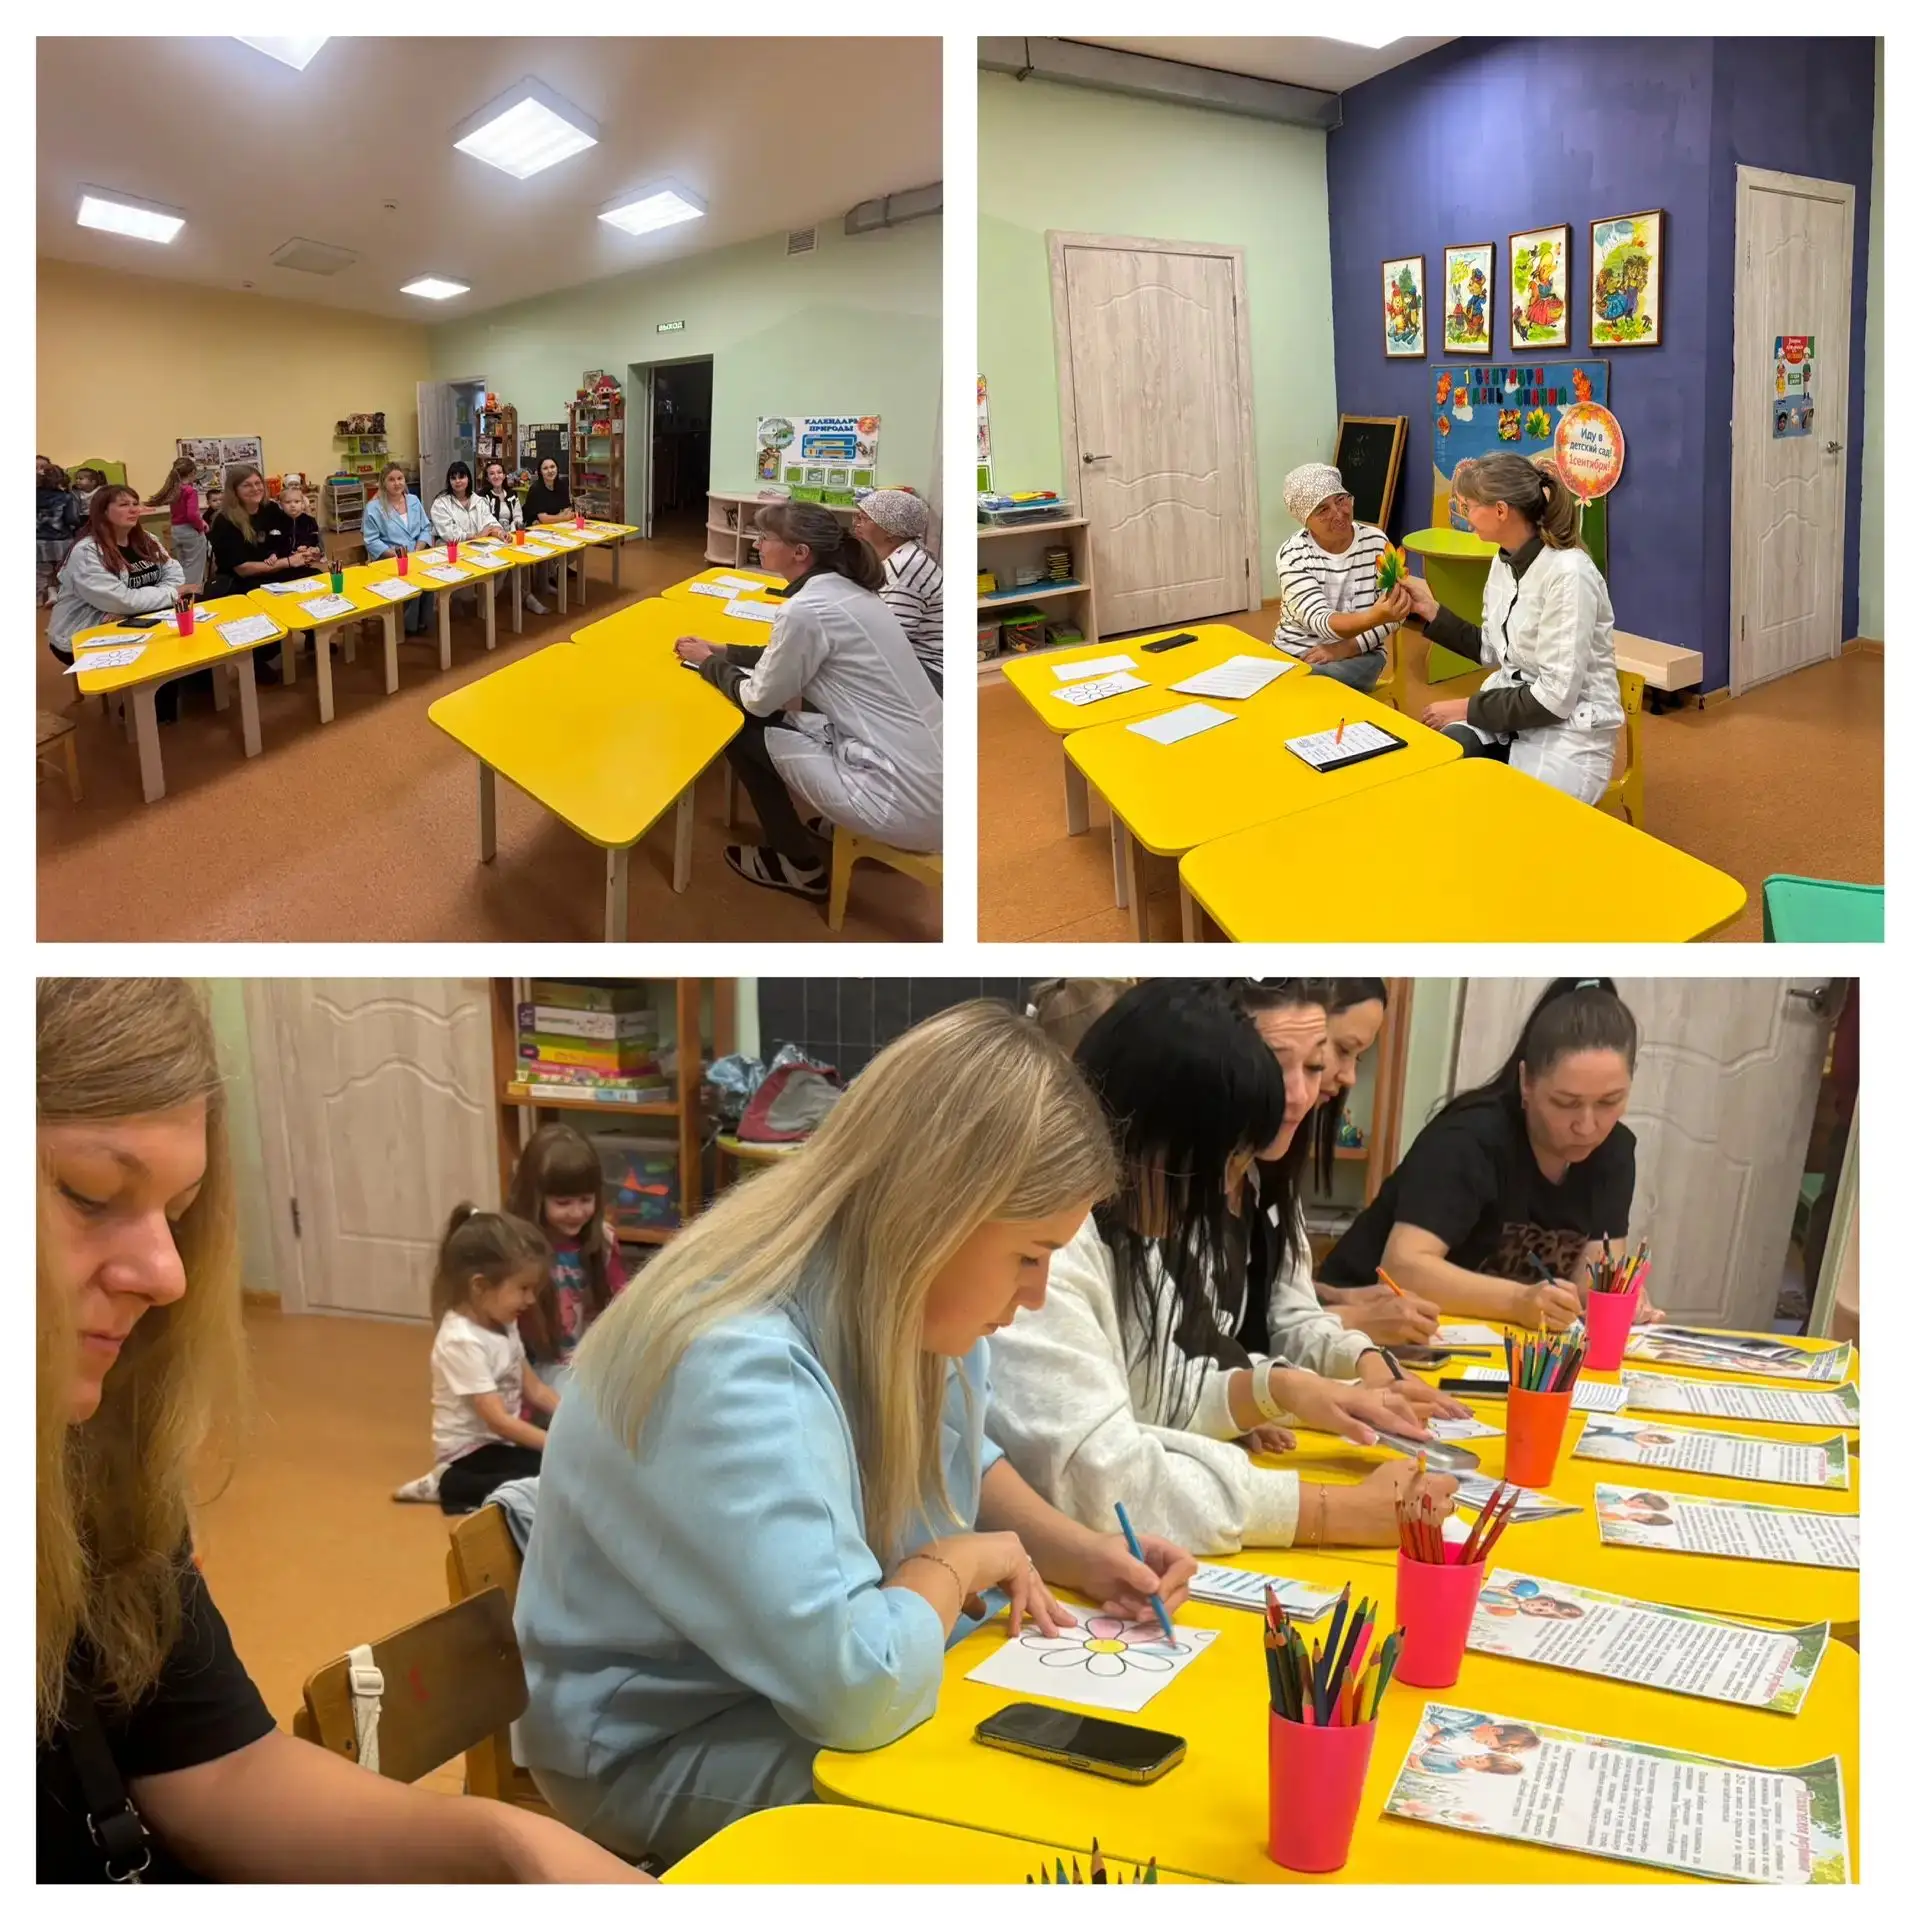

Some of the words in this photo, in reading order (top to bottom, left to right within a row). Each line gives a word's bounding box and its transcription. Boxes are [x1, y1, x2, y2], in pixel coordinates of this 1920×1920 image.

[658, 321, 683, 332] ВЫХОД
[1463, 368, 1471, 385] 1
[1475, 367, 1544, 386] СЕНТЯБРЯ
[1471, 387, 1504, 405] ДЕНЬ
[1515, 387, 1568, 407] ЗНАНИЙ
[1580, 427, 1597, 443] Иду
[1598, 433, 1603, 443] в
[1569, 440, 1597, 455] детский
[1597, 446, 1613, 459] сад!
